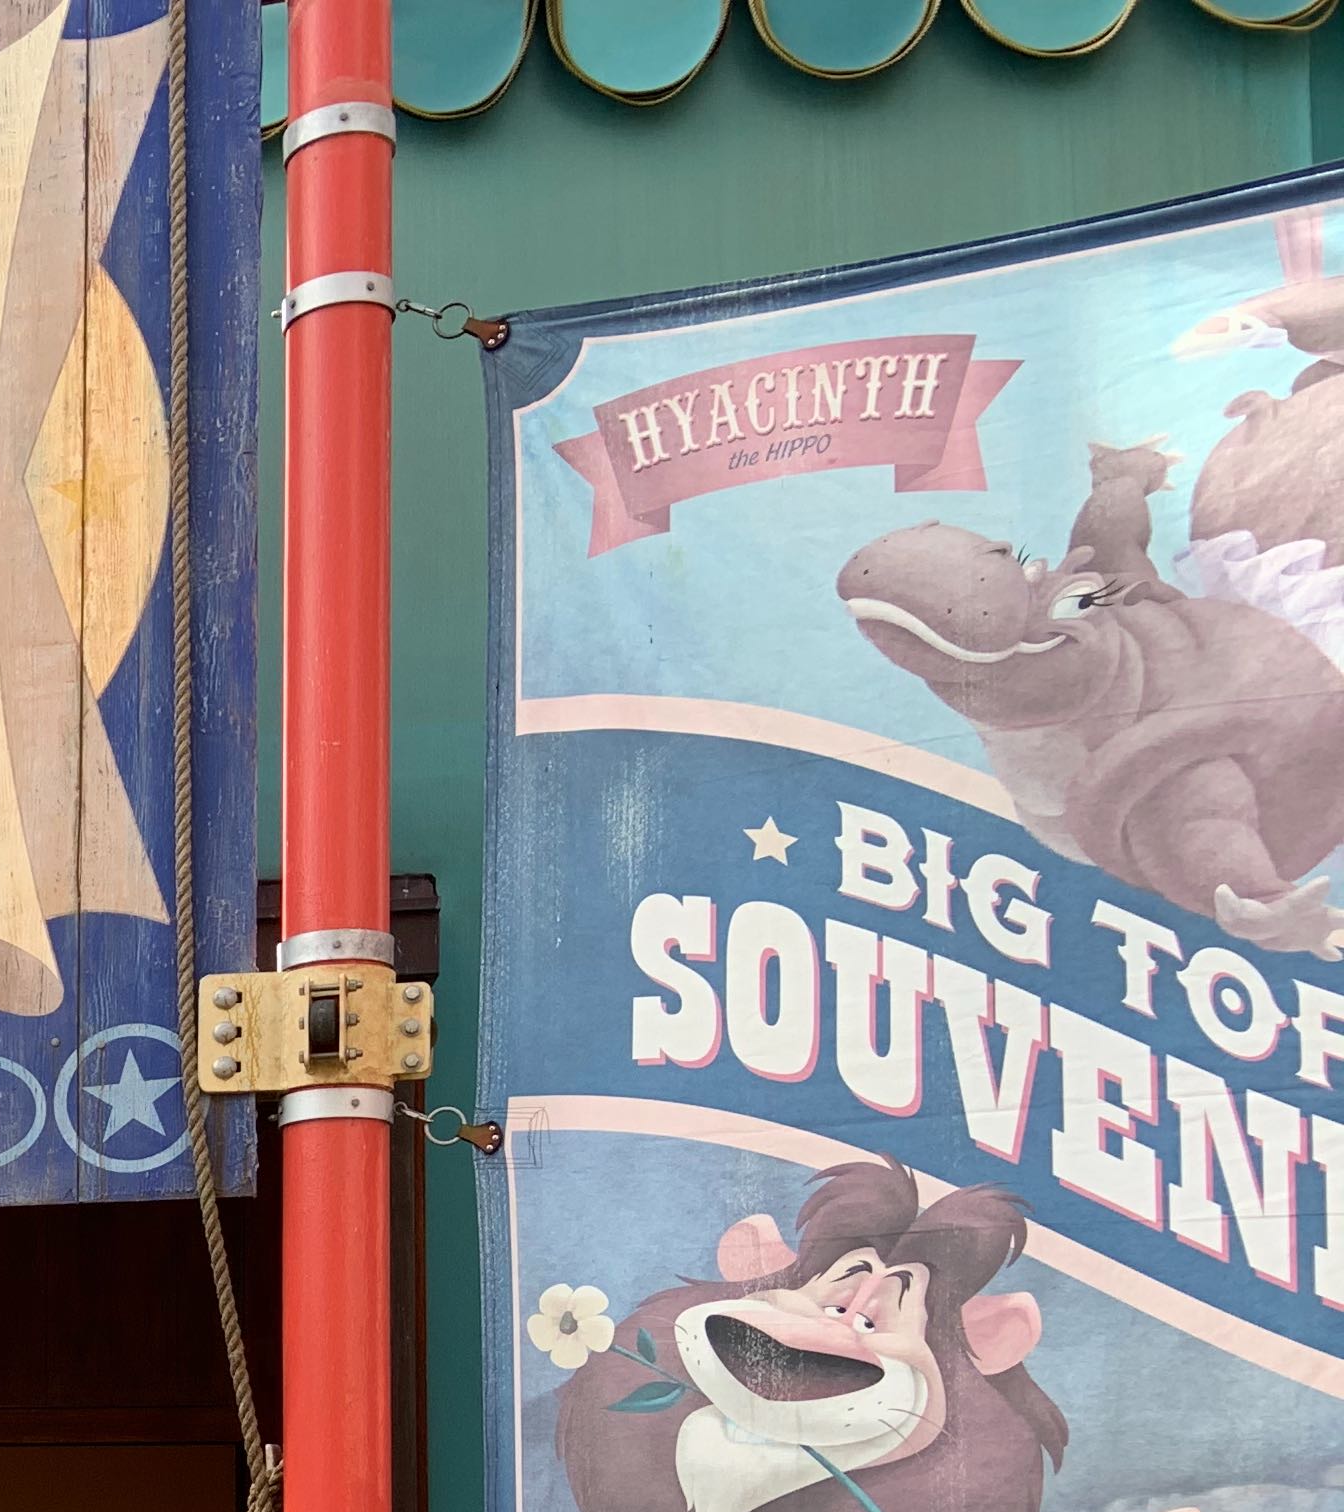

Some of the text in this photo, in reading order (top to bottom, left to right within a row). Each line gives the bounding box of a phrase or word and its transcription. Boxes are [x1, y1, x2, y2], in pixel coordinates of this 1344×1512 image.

[618, 352, 948, 473] HYACINTH
[728, 433, 832, 471] the HIPPO
[834, 800, 1053, 968] BIG
